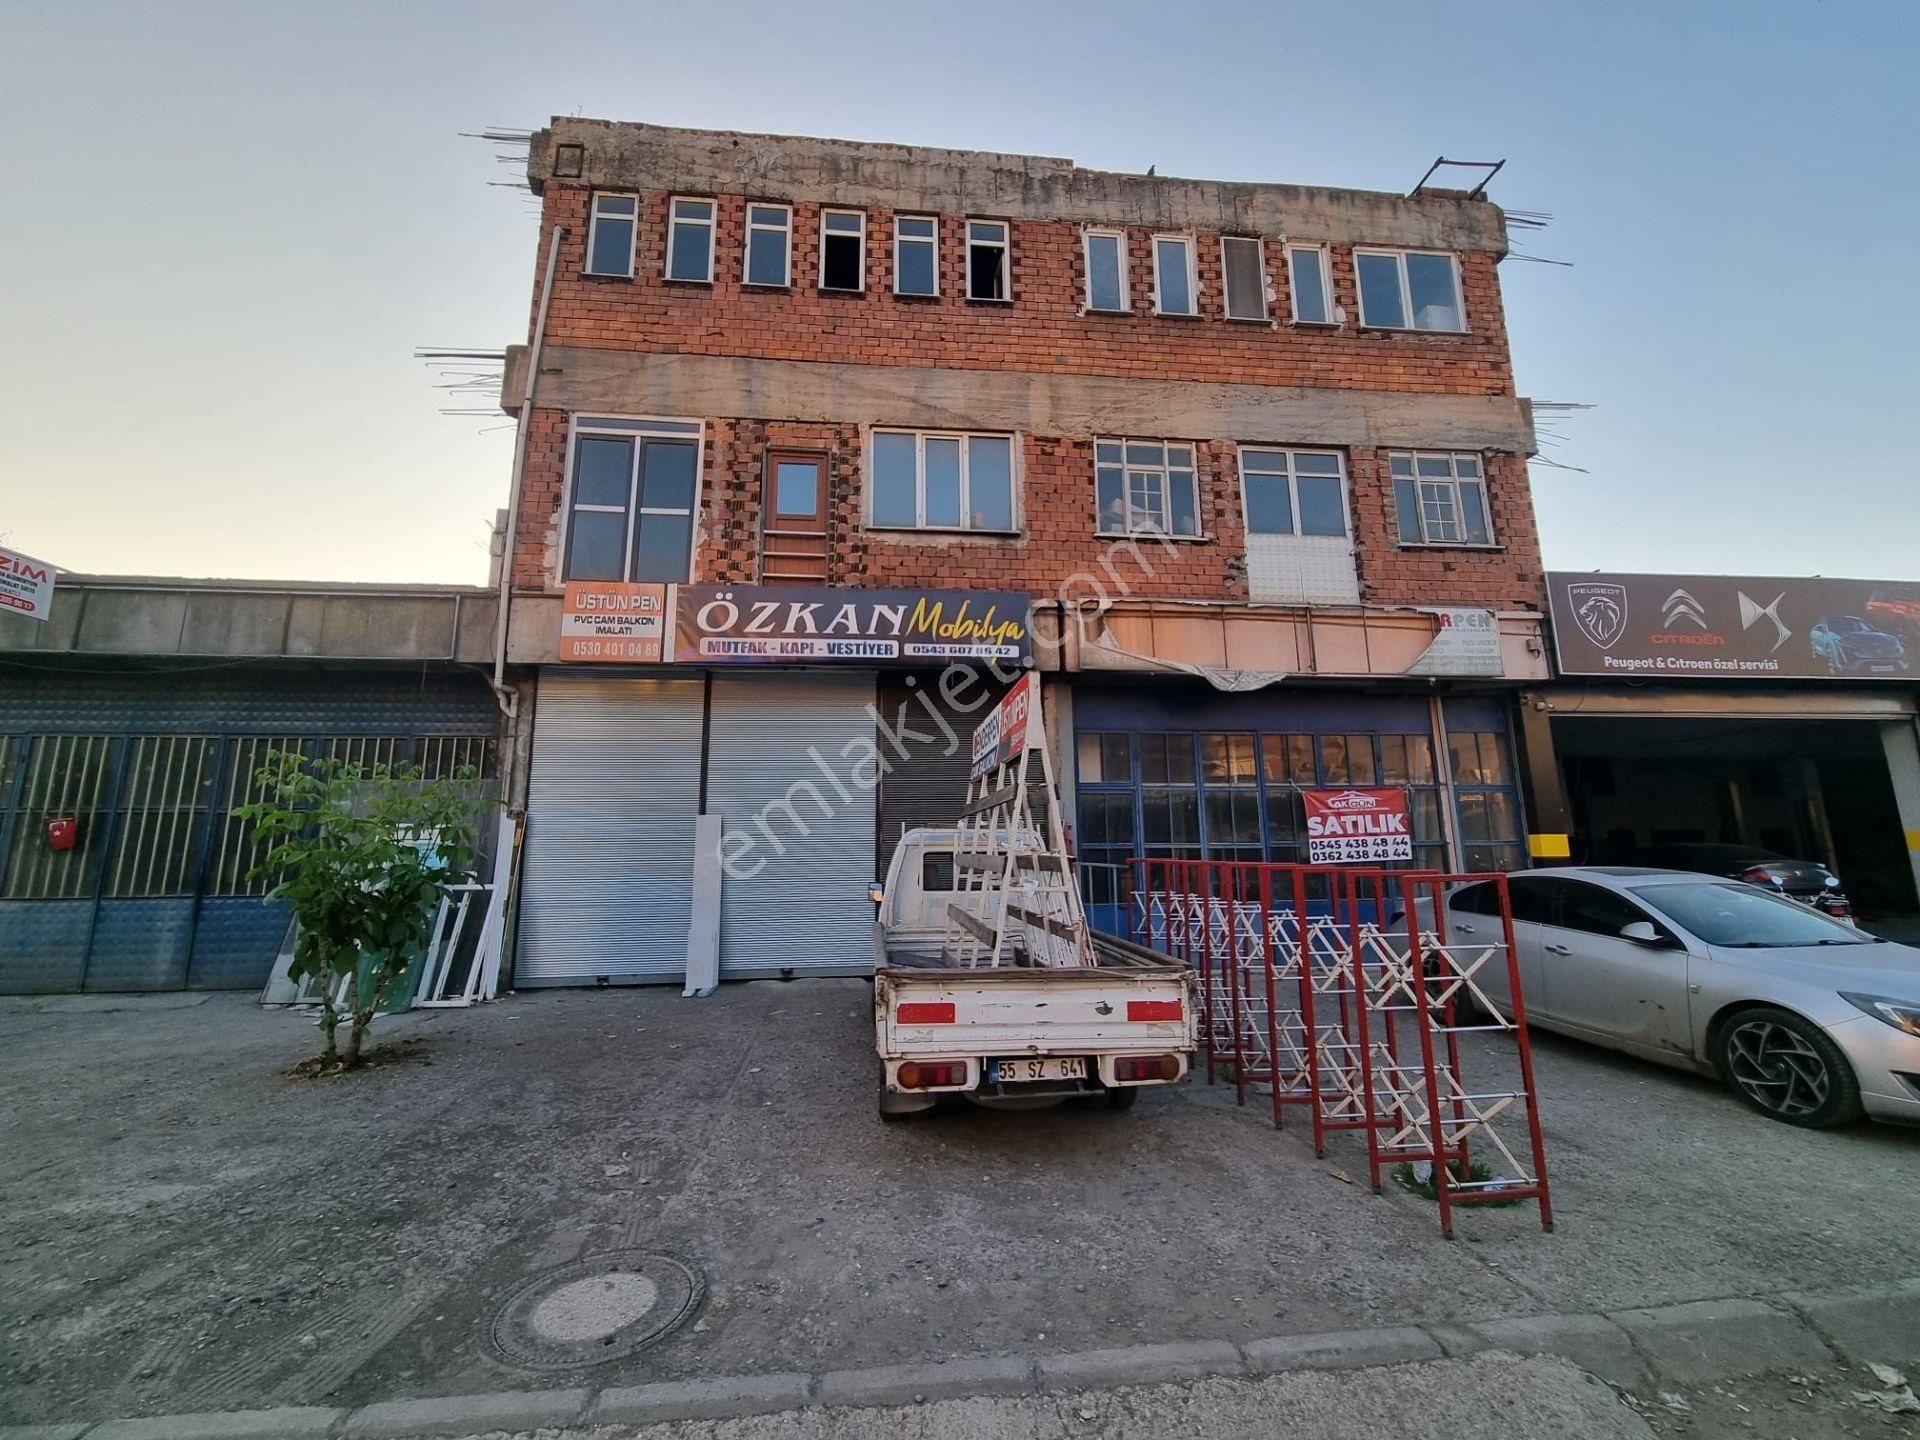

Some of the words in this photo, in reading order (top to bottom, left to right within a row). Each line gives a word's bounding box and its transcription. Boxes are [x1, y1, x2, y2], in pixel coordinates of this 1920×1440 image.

[1573, 588, 1620, 596] PEUGEOT
[576, 588, 628, 611] ÜSTÜN
[631, 594, 662, 612] PEN
[574, 615, 594, 624] PVC
[594, 615, 616, 625] CAM
[617, 616, 655, 626] BALKON
[696, 592, 909, 636] ÖZKAN
[905, 597, 1025, 666] Mobilya
[573, 641, 601, 656] 0530
[604, 642, 624, 656] 401
[628, 642, 642, 657] 04
[707, 641, 767, 653] MUTFAK
[780, 641, 814, 654] KAPI
[827, 641, 894, 656] VESTİYER
[912, 645, 945, 655] 0543
[949, 645, 972, 655] 607
[1604, 656, 1655, 671] Peugeot
[1656, 657, 1665, 668] &
[1739, 659, 1778, 670] servisi
[1307, 813, 1406, 836] SATILIK
[1310, 840, 1342, 850] 0545
[1345, 838, 1368, 848] 438
[1372, 837, 1388, 846] 48
[1392, 836, 1409, 846] 44
[1312, 851, 1343, 862] 0362
[1346, 849, 1370, 860] 438
[1373, 848, 1389, 858] 48
[1393, 847, 1410, 857] 44
[999, 1062, 1016, 1079] 55
[1028, 1061, 1045, 1078] SZ
[1060, 1059, 1084, 1077] 641
